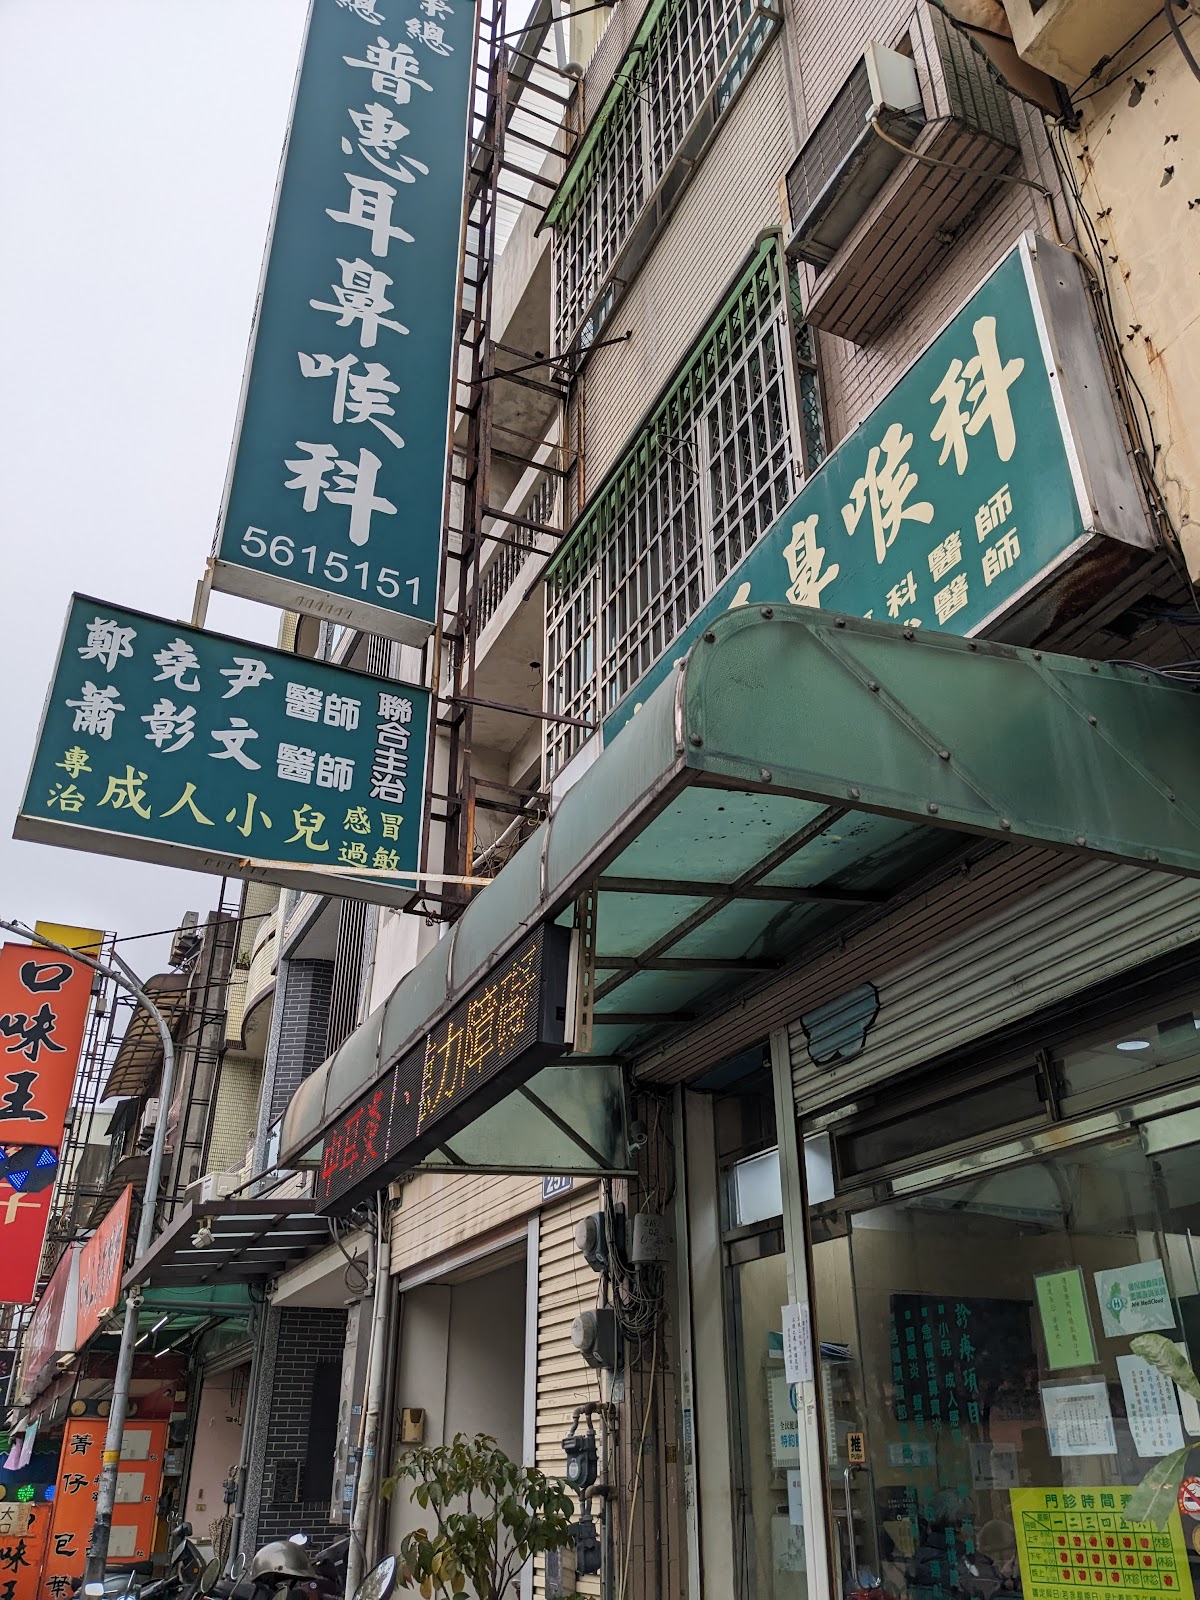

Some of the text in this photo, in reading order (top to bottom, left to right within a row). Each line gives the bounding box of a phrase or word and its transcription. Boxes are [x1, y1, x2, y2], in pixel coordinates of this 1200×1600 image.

[284, 36, 434, 546] 普惠耳鼻喉科
[240, 526, 421, 605] 5615151
[285, 681, 362, 732] 醫師
[47, 746, 93, 812] 專治
[276, 742, 356, 792] 醫師
[369, 691, 413, 804] 聯合主治
[96, 766, 330, 852] 成人小兒
[343, 806, 404, 841] 感冒
[0, 960, 74, 1121] 口味王
[850, 1435, 861, 1452] 推
